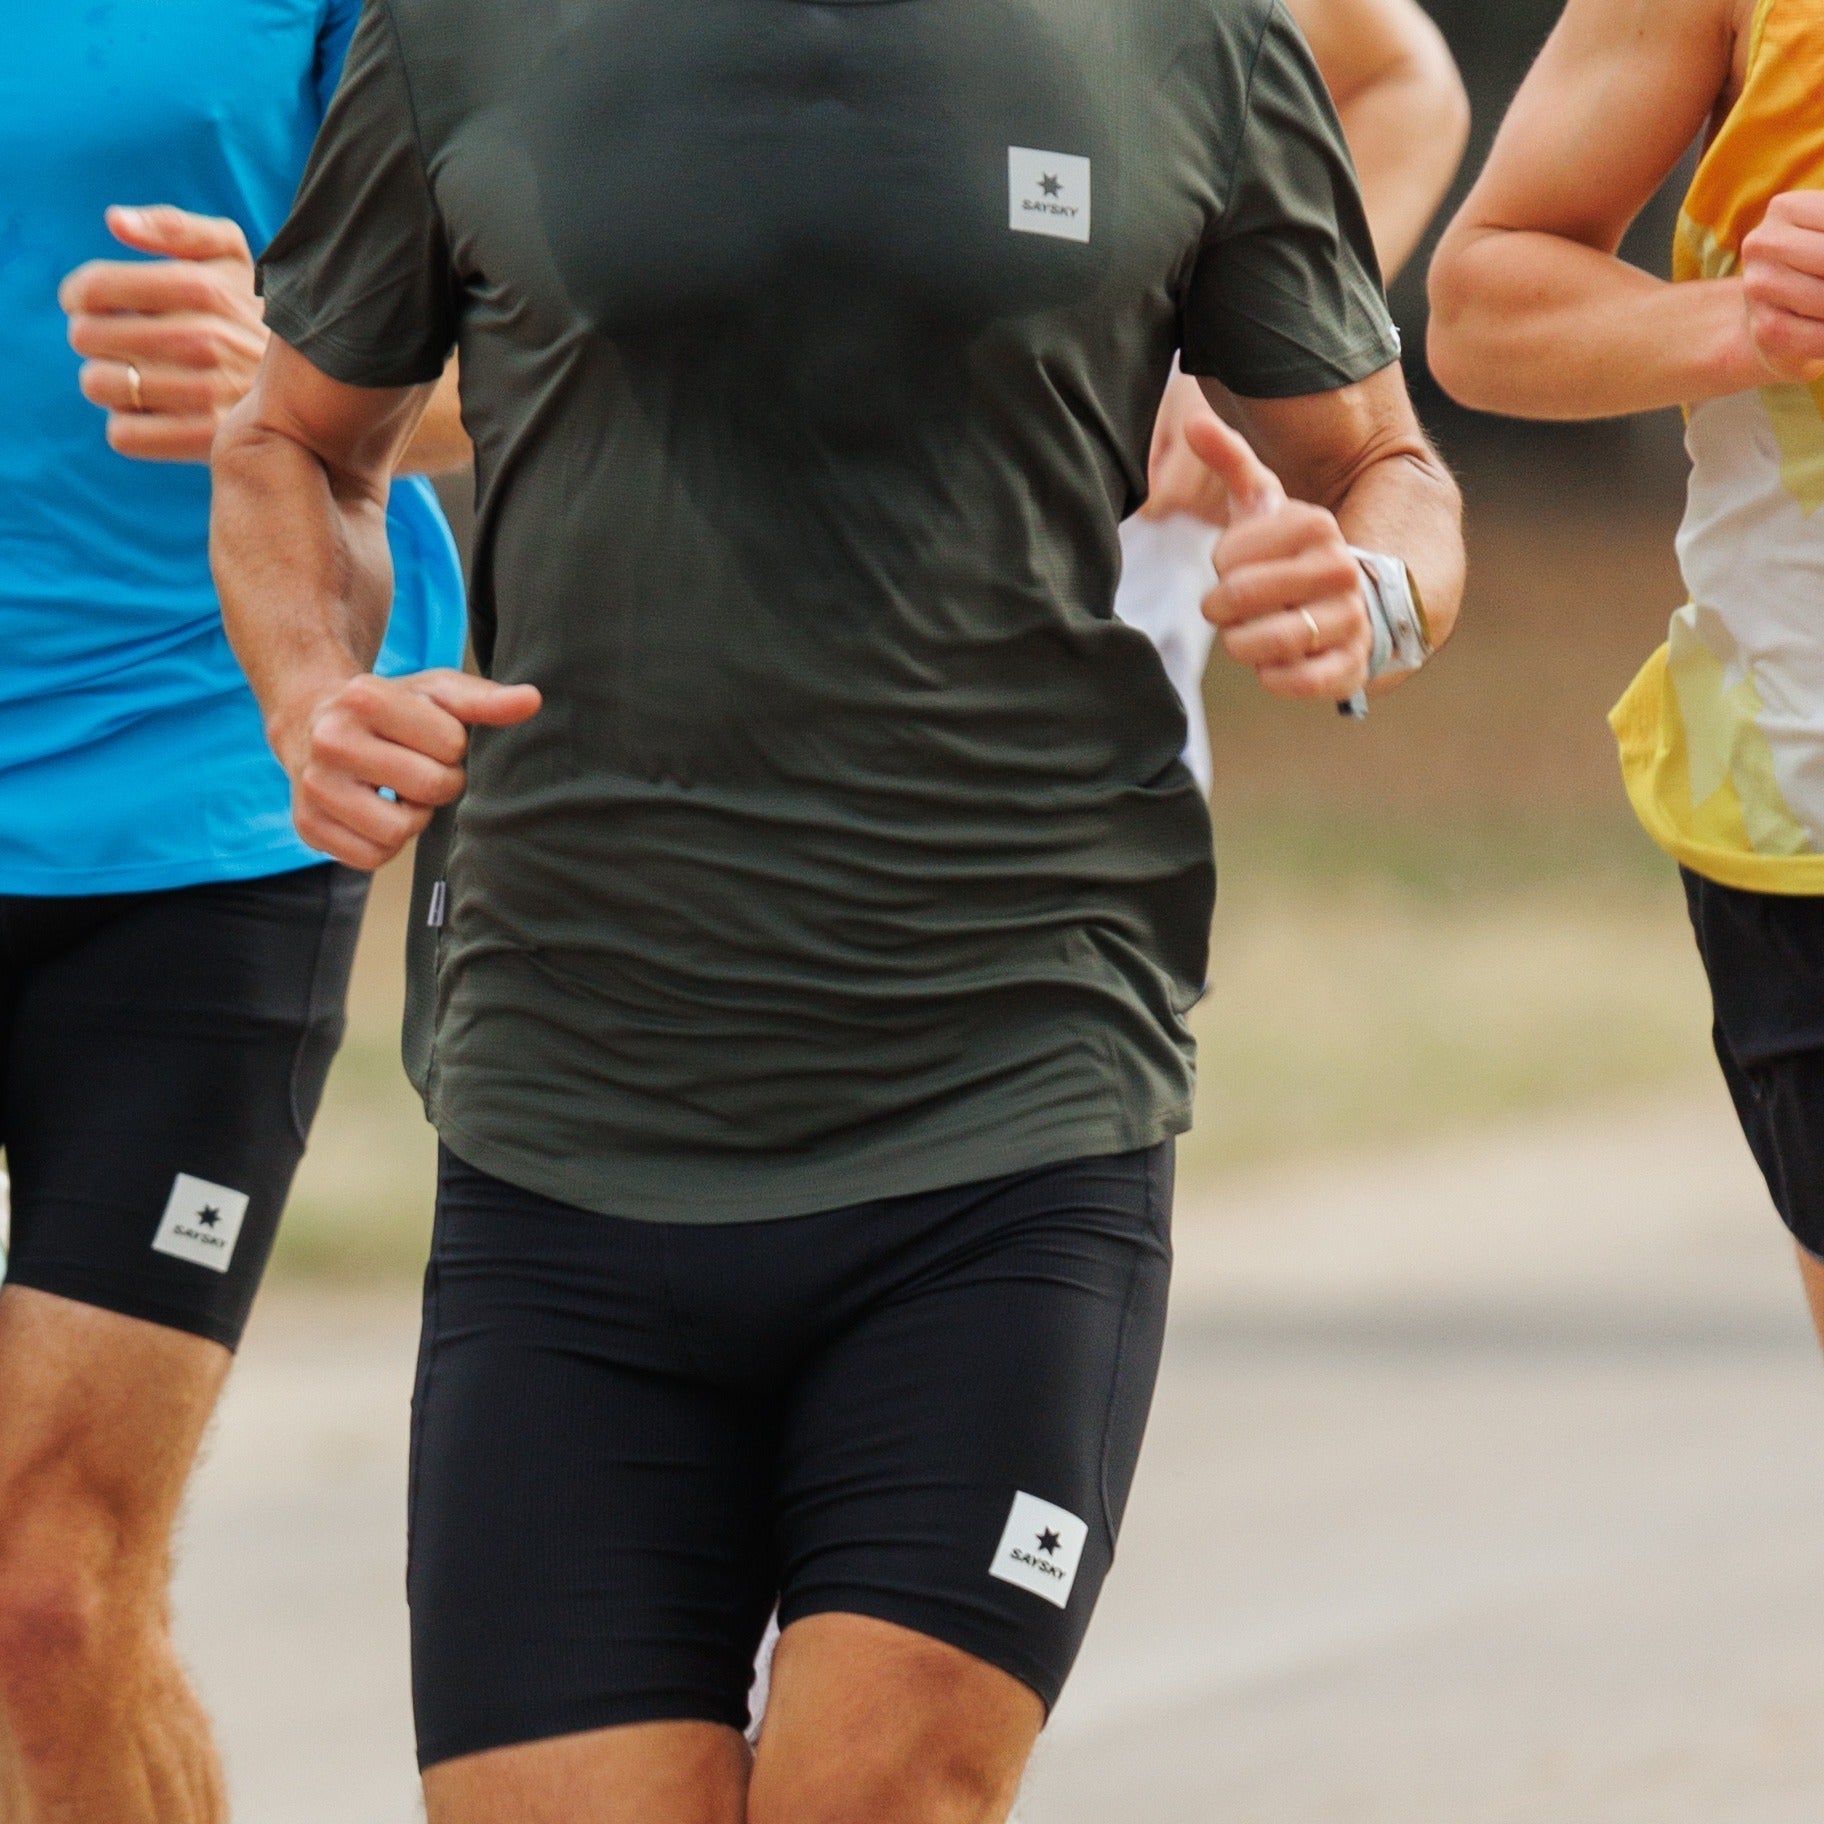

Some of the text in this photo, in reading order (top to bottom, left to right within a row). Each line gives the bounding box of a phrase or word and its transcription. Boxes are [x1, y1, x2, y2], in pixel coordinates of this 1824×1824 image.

[1022, 198, 1079, 217] SAYSKY
[173, 1225, 226, 1248] SAYSKY
[1010, 1547, 1065, 1580] SAYSKY
